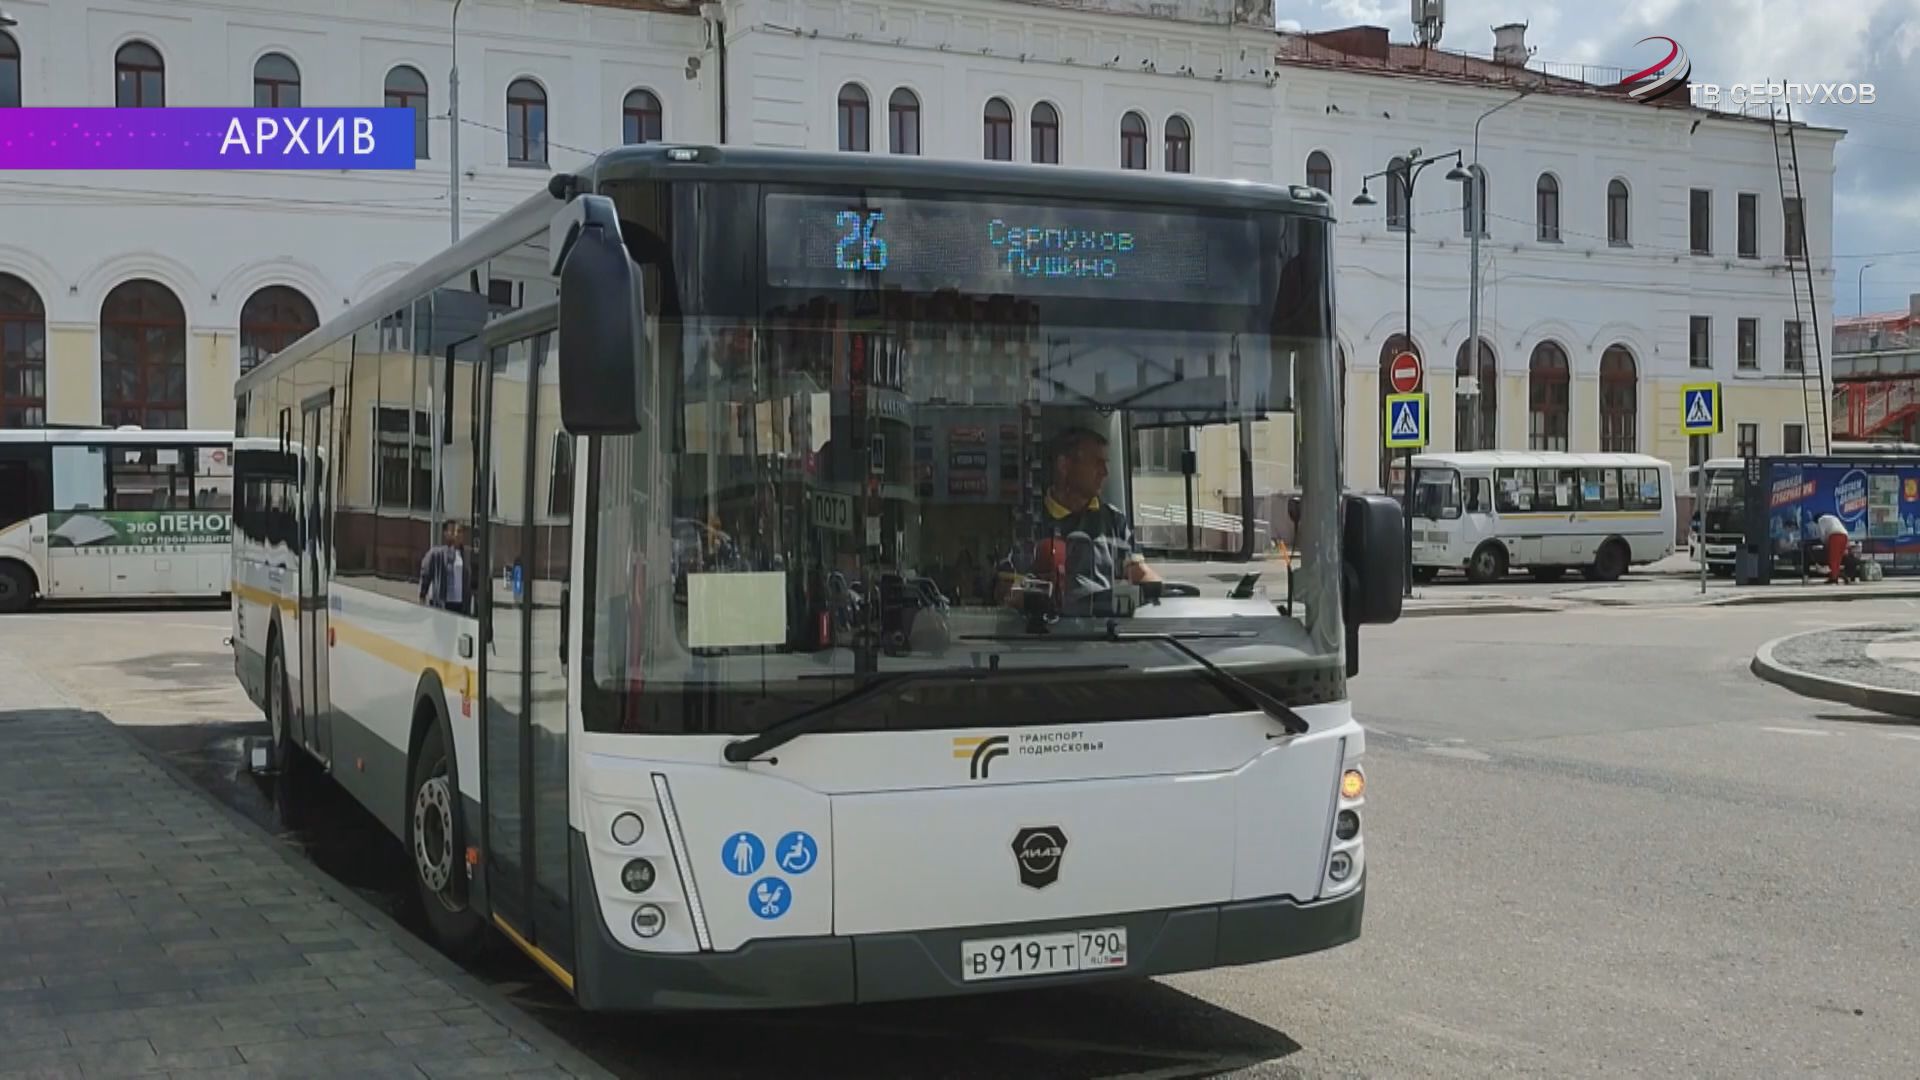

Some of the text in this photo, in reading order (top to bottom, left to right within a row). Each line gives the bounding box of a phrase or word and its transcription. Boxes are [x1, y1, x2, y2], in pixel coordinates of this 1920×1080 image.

[836, 211, 889, 271] 26
[988, 219, 1135, 254] Серпухов
[1019, 731, 1084, 743] ТРАНСПОРТ
[1019, 742, 1104, 755] ПОДМОСКОВЬЯ
[1081, 932, 1120, 957] 790
